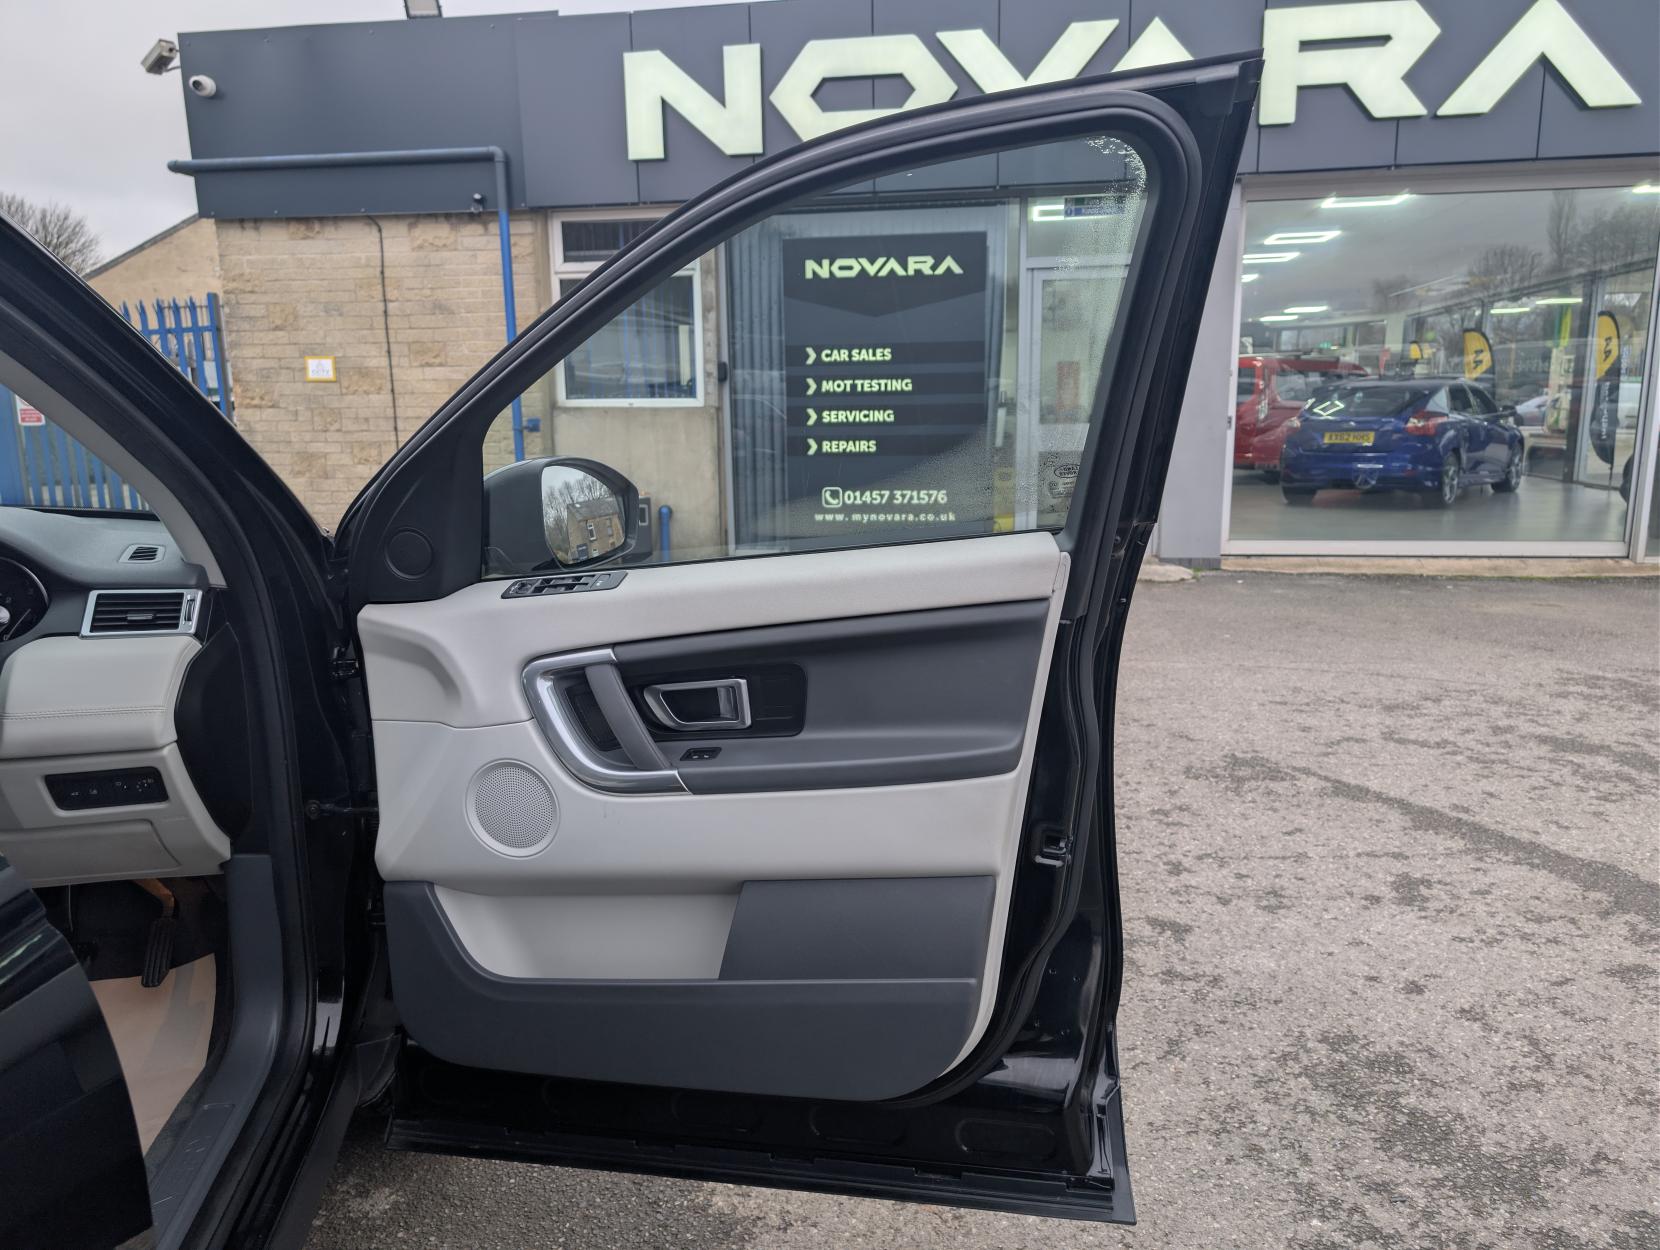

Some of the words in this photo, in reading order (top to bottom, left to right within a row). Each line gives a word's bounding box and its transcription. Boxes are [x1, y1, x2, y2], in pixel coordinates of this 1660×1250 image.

[805, 255, 963, 279] NOVARA
[821, 350, 849, 361] CAR
[851, 348, 892, 361] SALES
[821, 380, 853, 392] MOT
[855, 379, 912, 391] TESTING
[821, 410, 895, 423] SERVICING
[822, 440, 877, 452] REPAIRS
[844, 491, 890, 505] 01457
[893, 490, 948, 504] 371576
